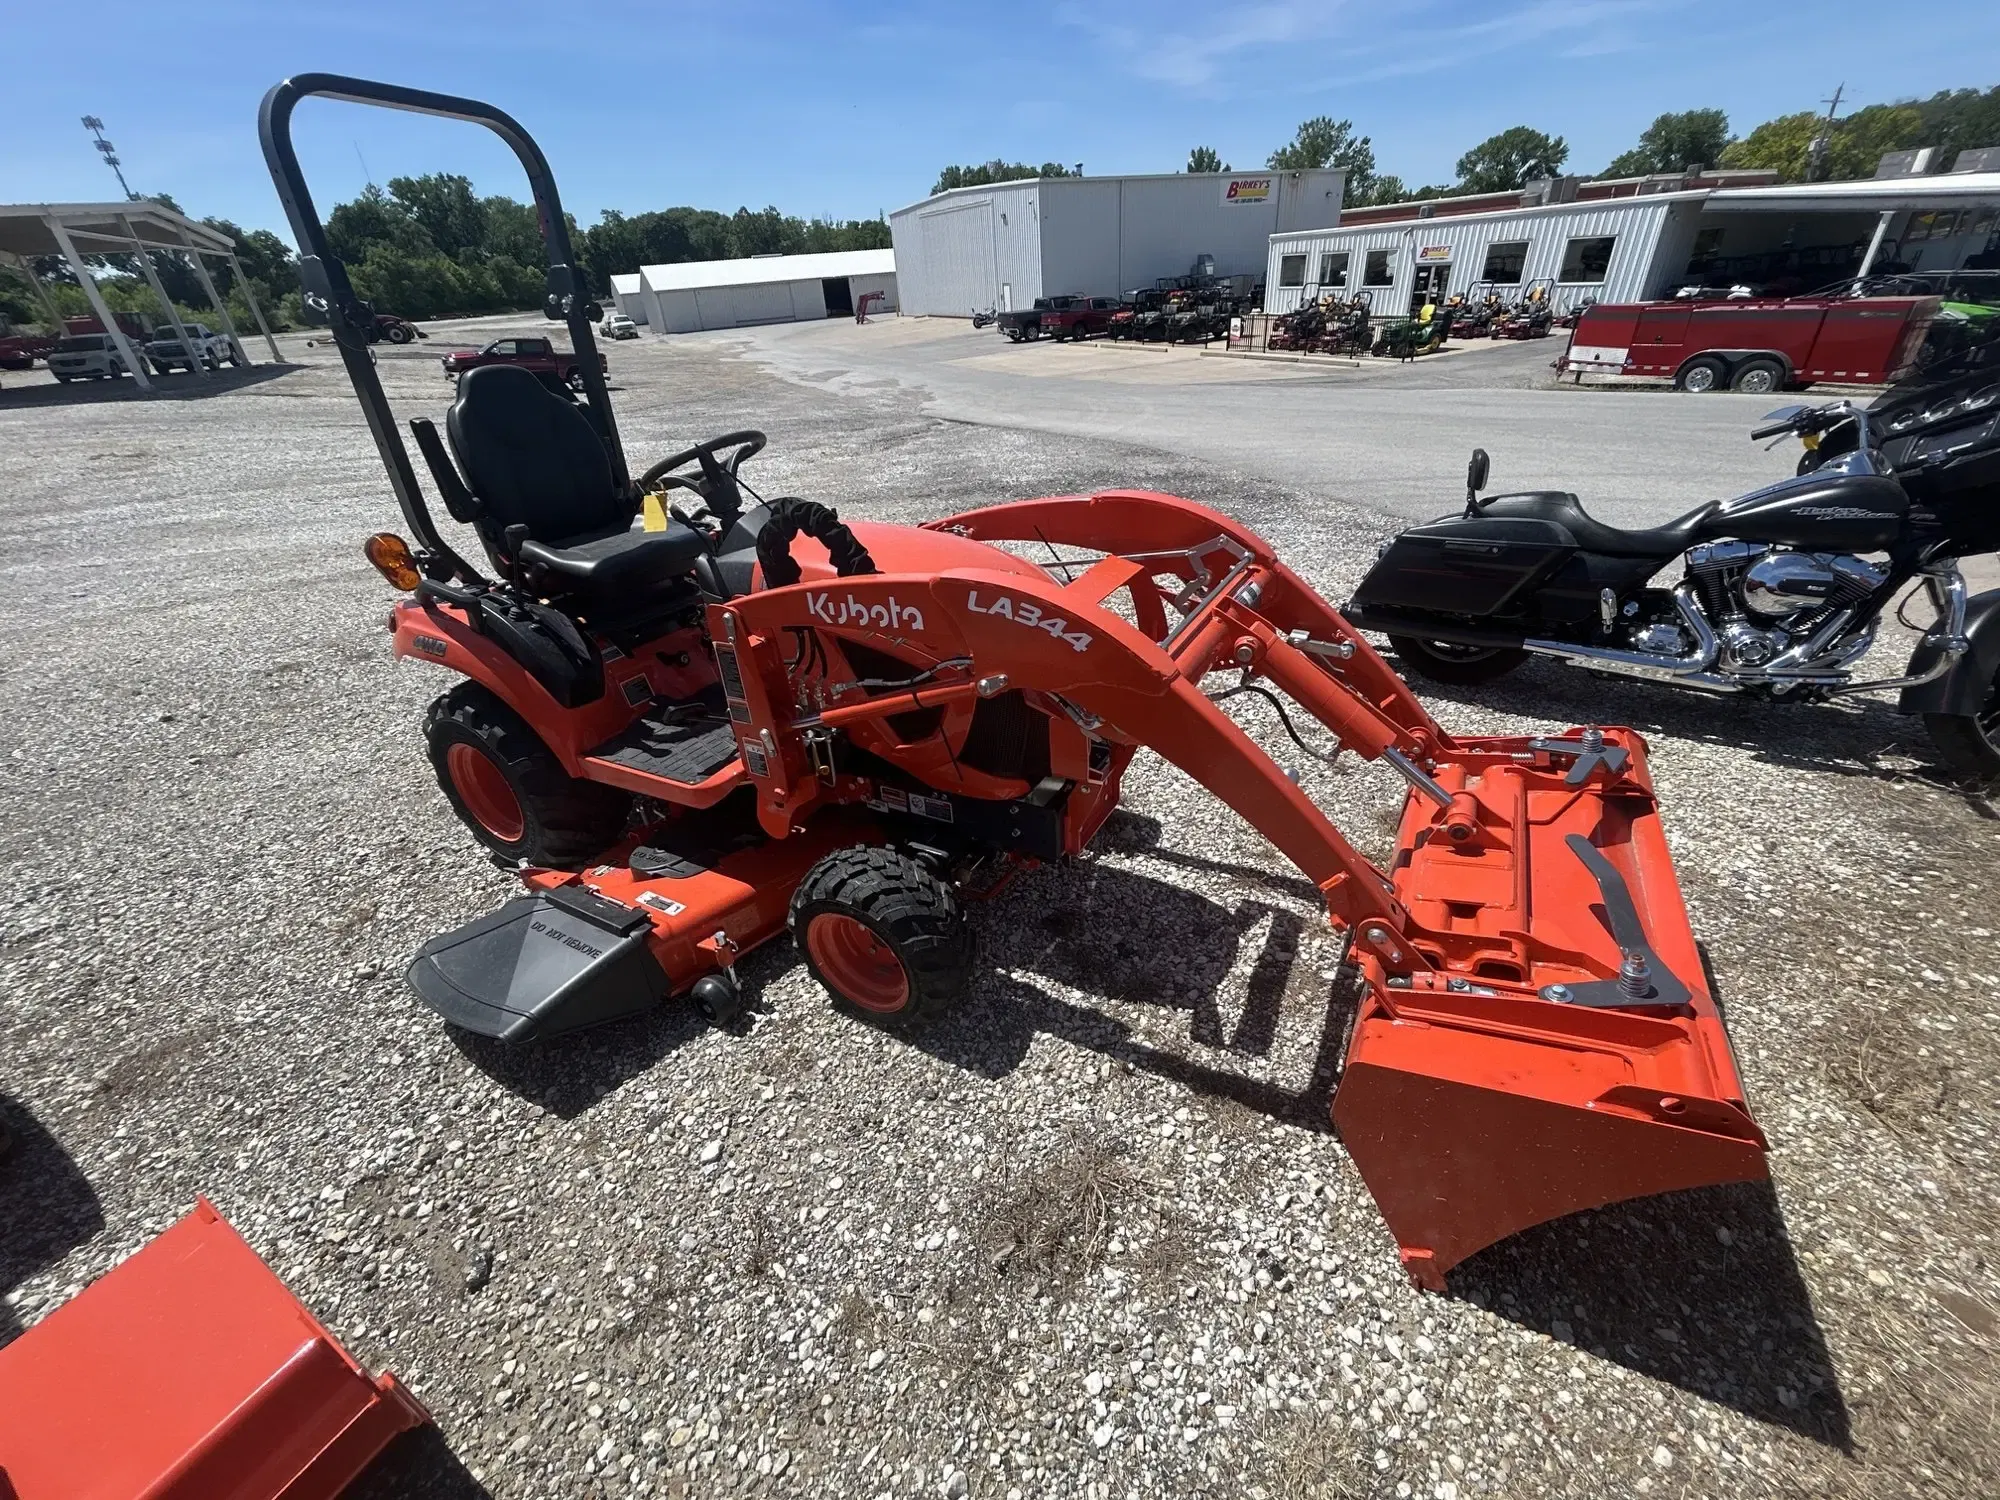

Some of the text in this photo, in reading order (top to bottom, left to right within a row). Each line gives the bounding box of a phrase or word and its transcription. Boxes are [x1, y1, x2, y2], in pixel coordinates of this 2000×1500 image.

[1226, 180, 1271, 199] BIRKEY'S
[806, 591, 924, 631] Kubota
[967, 590, 1094, 653] LA344
[530, 921, 602, 959] DO NOT REMOVE
